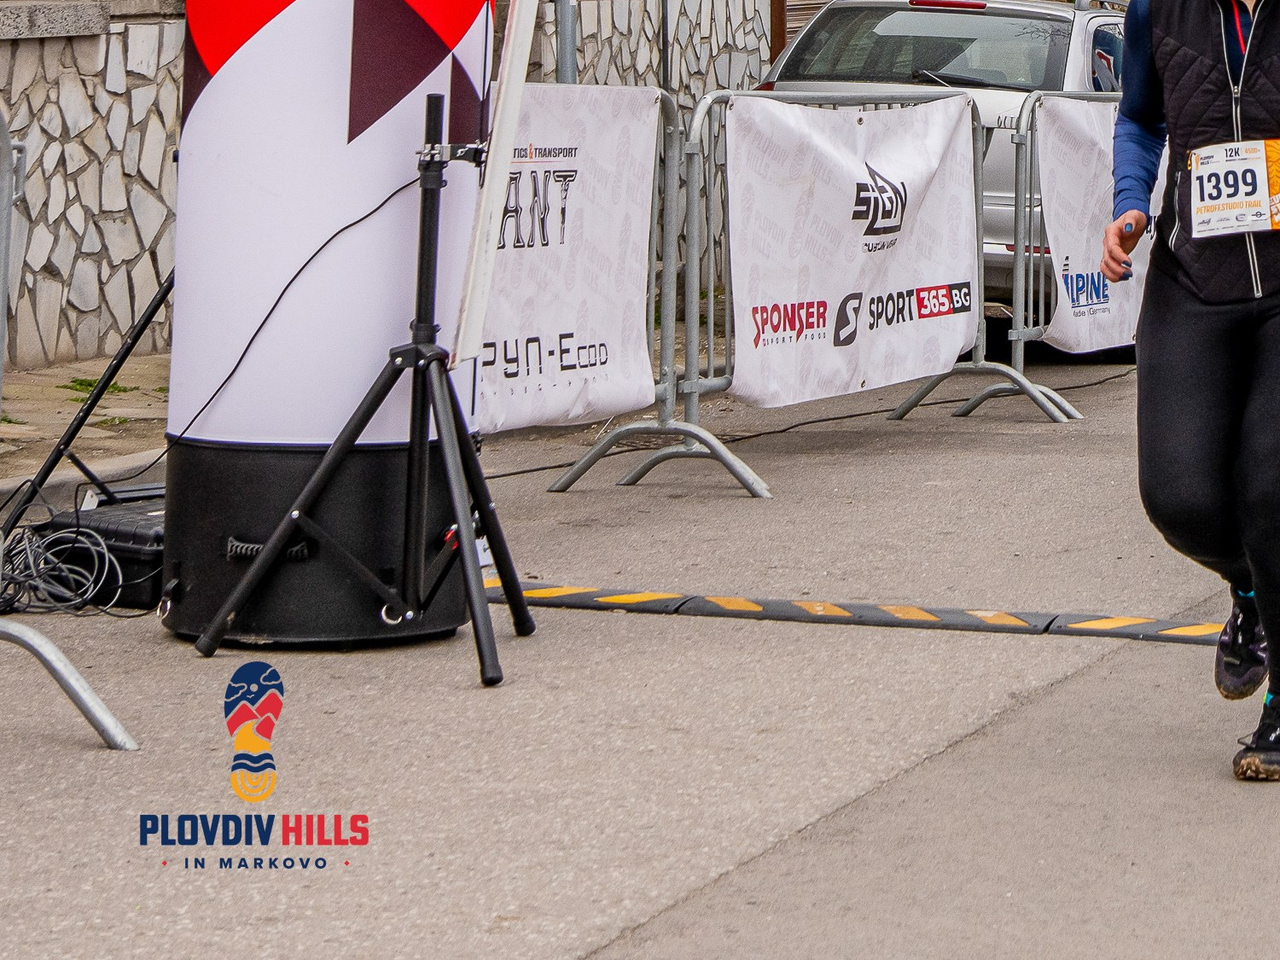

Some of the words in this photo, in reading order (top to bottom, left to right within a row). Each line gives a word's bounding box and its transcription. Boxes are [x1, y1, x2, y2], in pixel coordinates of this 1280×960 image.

[1225, 147, 1241, 158] 12K
[1195, 168, 1258, 203] 1399
[1245, 200, 1262, 208] TRAIL
[752, 300, 828, 349] SPONSER
